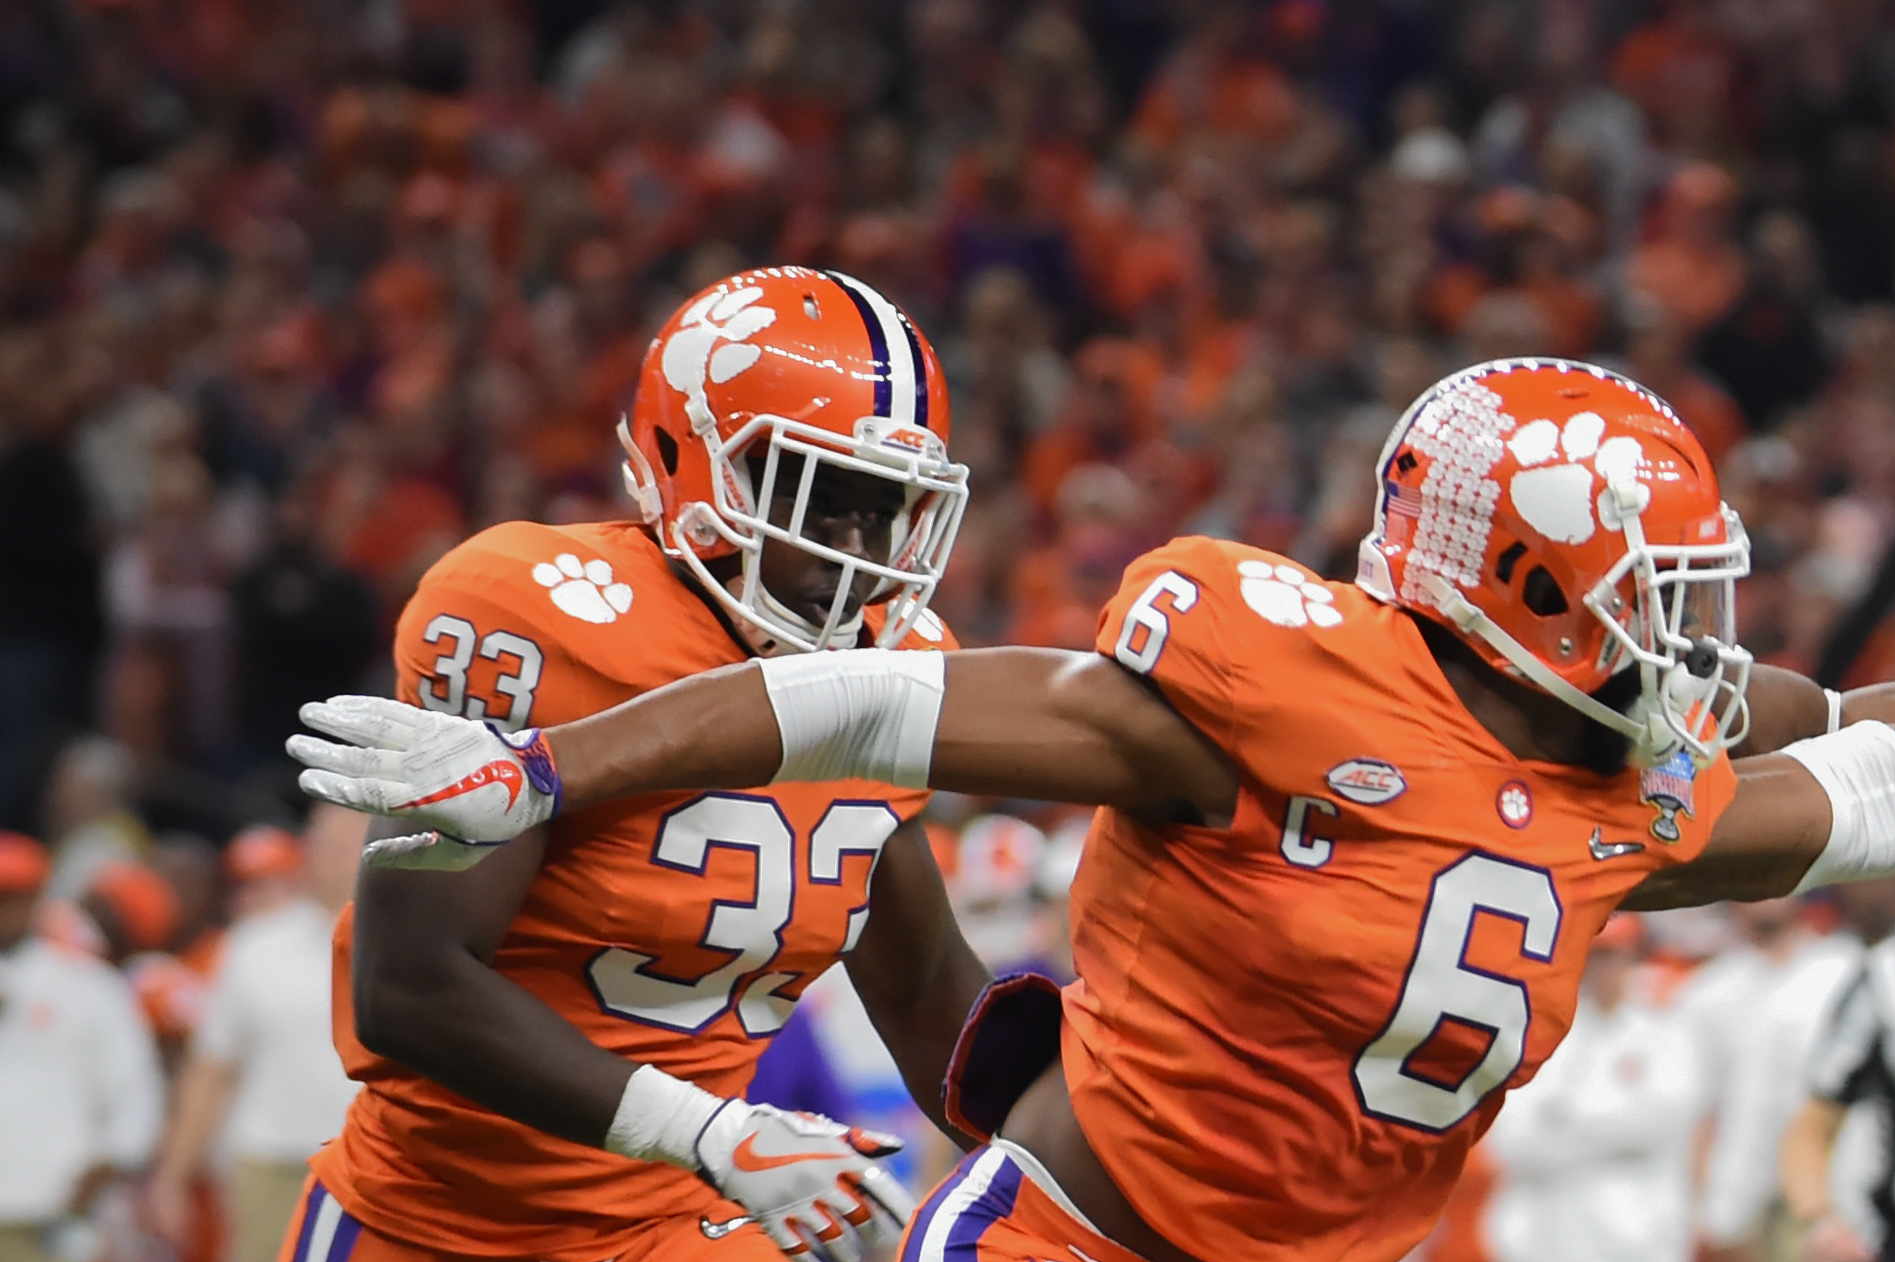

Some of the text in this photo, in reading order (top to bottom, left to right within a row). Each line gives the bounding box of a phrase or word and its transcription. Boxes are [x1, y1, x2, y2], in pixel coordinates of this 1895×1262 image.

[886, 428, 926, 448] ACC
[418, 612, 545, 734] 33
[1112, 569, 1200, 676] 6
[1279, 795, 1341, 869] C
[1339, 769, 1396, 789] ACC
[584, 790, 901, 1039] 33
[1350, 849, 1564, 1135] 6
